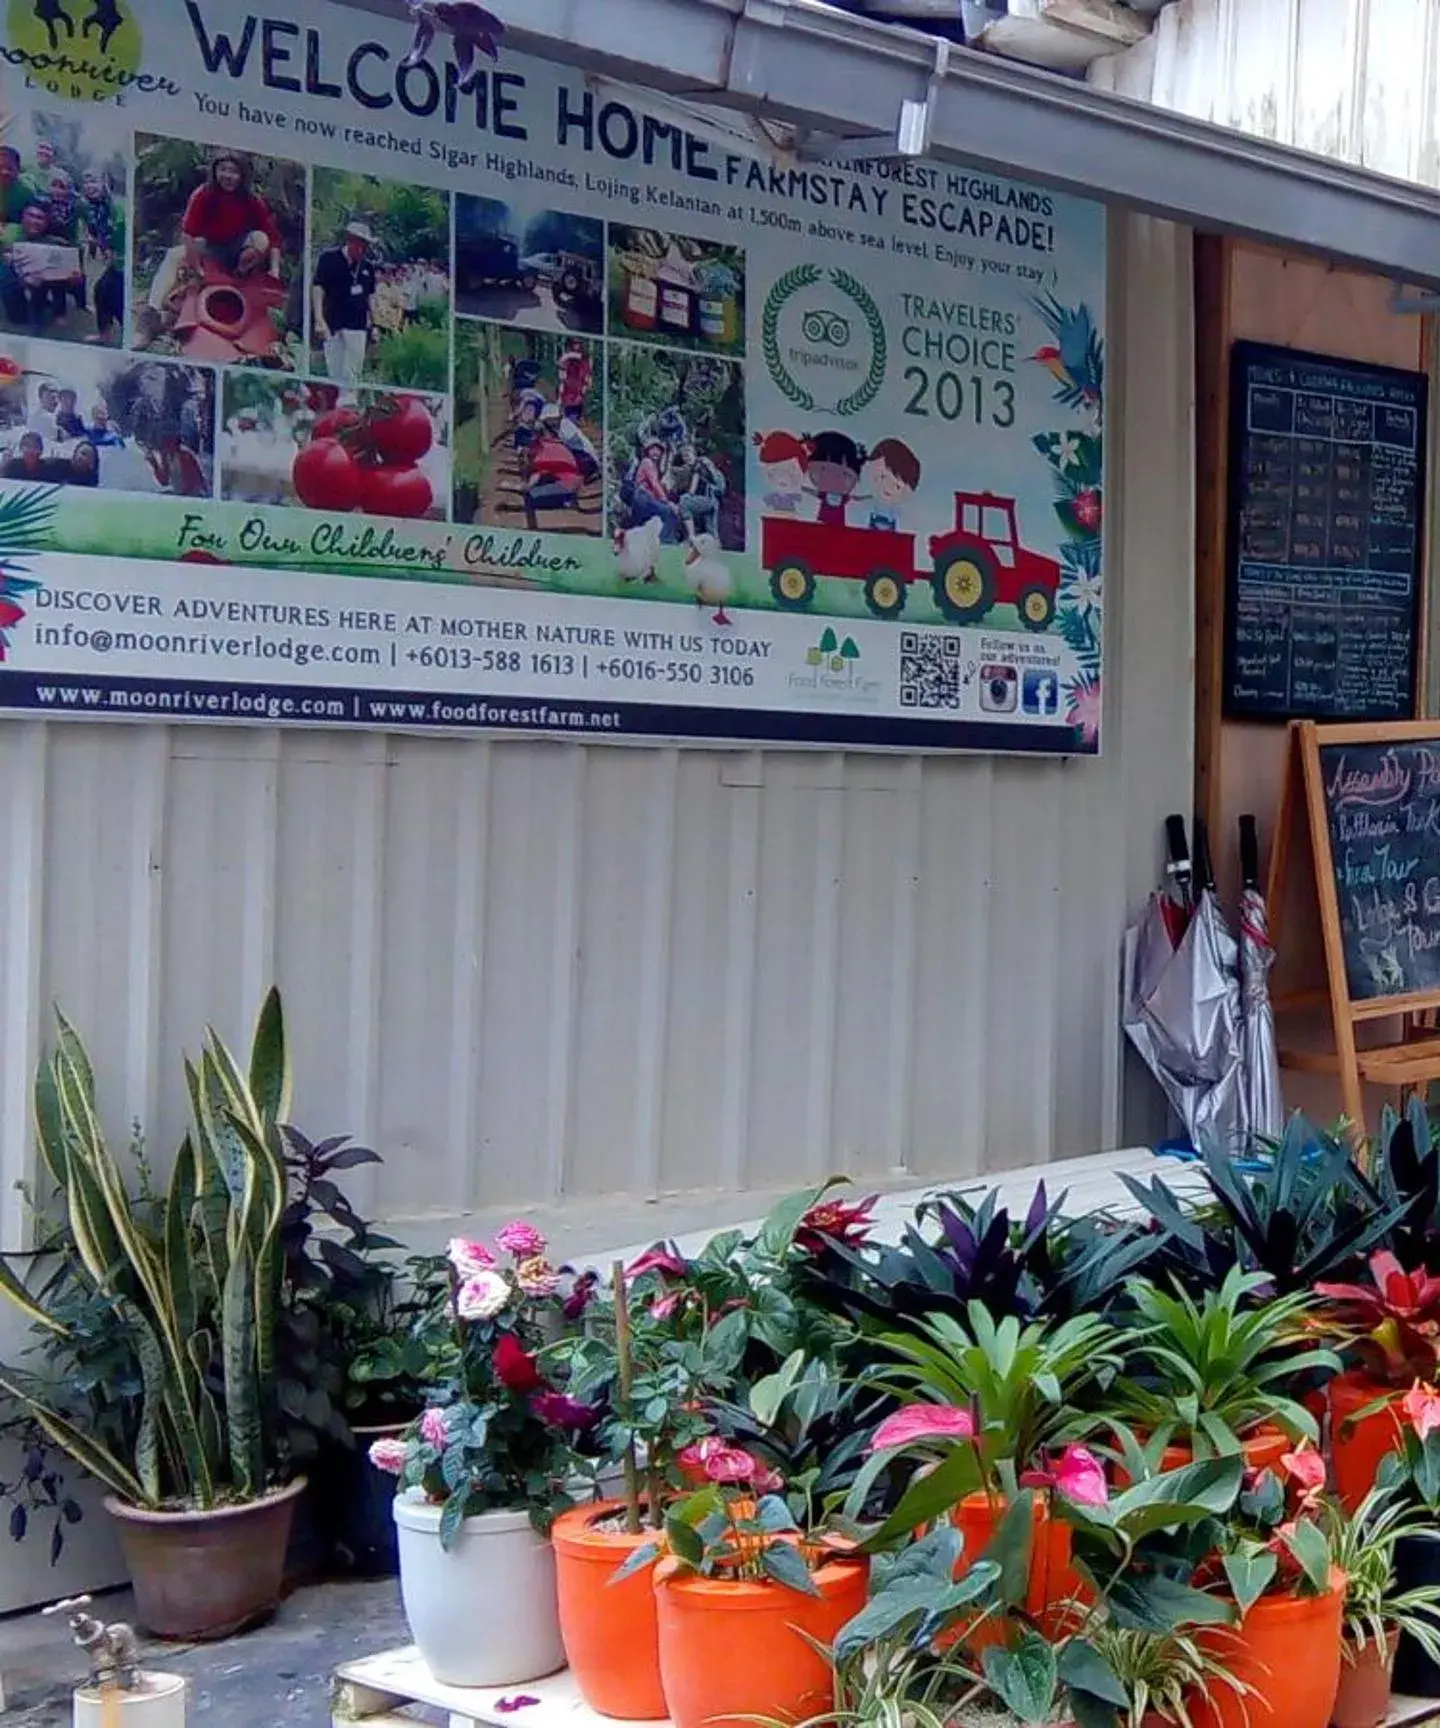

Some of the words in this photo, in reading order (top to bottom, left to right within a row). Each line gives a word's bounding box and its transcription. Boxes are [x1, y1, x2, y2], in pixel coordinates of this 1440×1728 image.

[0, 46, 182, 96] oonriver
[187, 0, 528, 142] WELCOME
[557, 85, 718, 182] HOME
[194, 91, 230, 118] You
[238, 102, 286, 129] have
[294, 117, 337, 140] now
[344, 125, 421, 157] reached
[429, 141, 478, 169] Sigar
[585, 174, 640, 206] Lojing
[646, 184, 721, 219] Kelantan
[726, 201, 744, 221] at
[809, 218, 855, 244] above
[861, 231, 886, 250] sea
[934, 243, 976, 271] Enjoy
[981, 257, 1012, 275] your
[725, 154, 889, 216] FARMSTAY
[902, 193, 1055, 253] ESCAPADE!
[946, 173, 1053, 217] HIGHLANDS
[901, 325, 1016, 373] CHOICE
[902, 366, 1016, 429] 2013
[177, 514, 228, 552] For
[239, 518, 301, 553] Our
[463, 533, 583, 573] Children
[35, 588, 163, 618] DISCOVER
[173, 598, 330, 629] ADVENTURES
[338, 610, 397, 632] HERE
[404, 615, 431, 634] AT
[440, 618, 528, 642] MOTHER
[537, 624, 616, 648] NATURE
[624, 628, 675, 650] WITH
[680, 633, 702, 652] US
[709, 637, 772, 659] TODAY
[35, 623, 381, 666] info@moonriverlodge.com
[406, 646, 522, 673] +6013-588
[531, 652, 575, 676] 1613
[597, 659, 701, 684] +6016-550
[709, 666, 755, 687] 3106
[36, 683, 345, 719] www.moonriverlodge.com
[370, 700, 621, 729] www.foodforestfarm.net
[1327, 747, 1411, 805] Assembly
[1374, 844, 1420, 881] Tour
